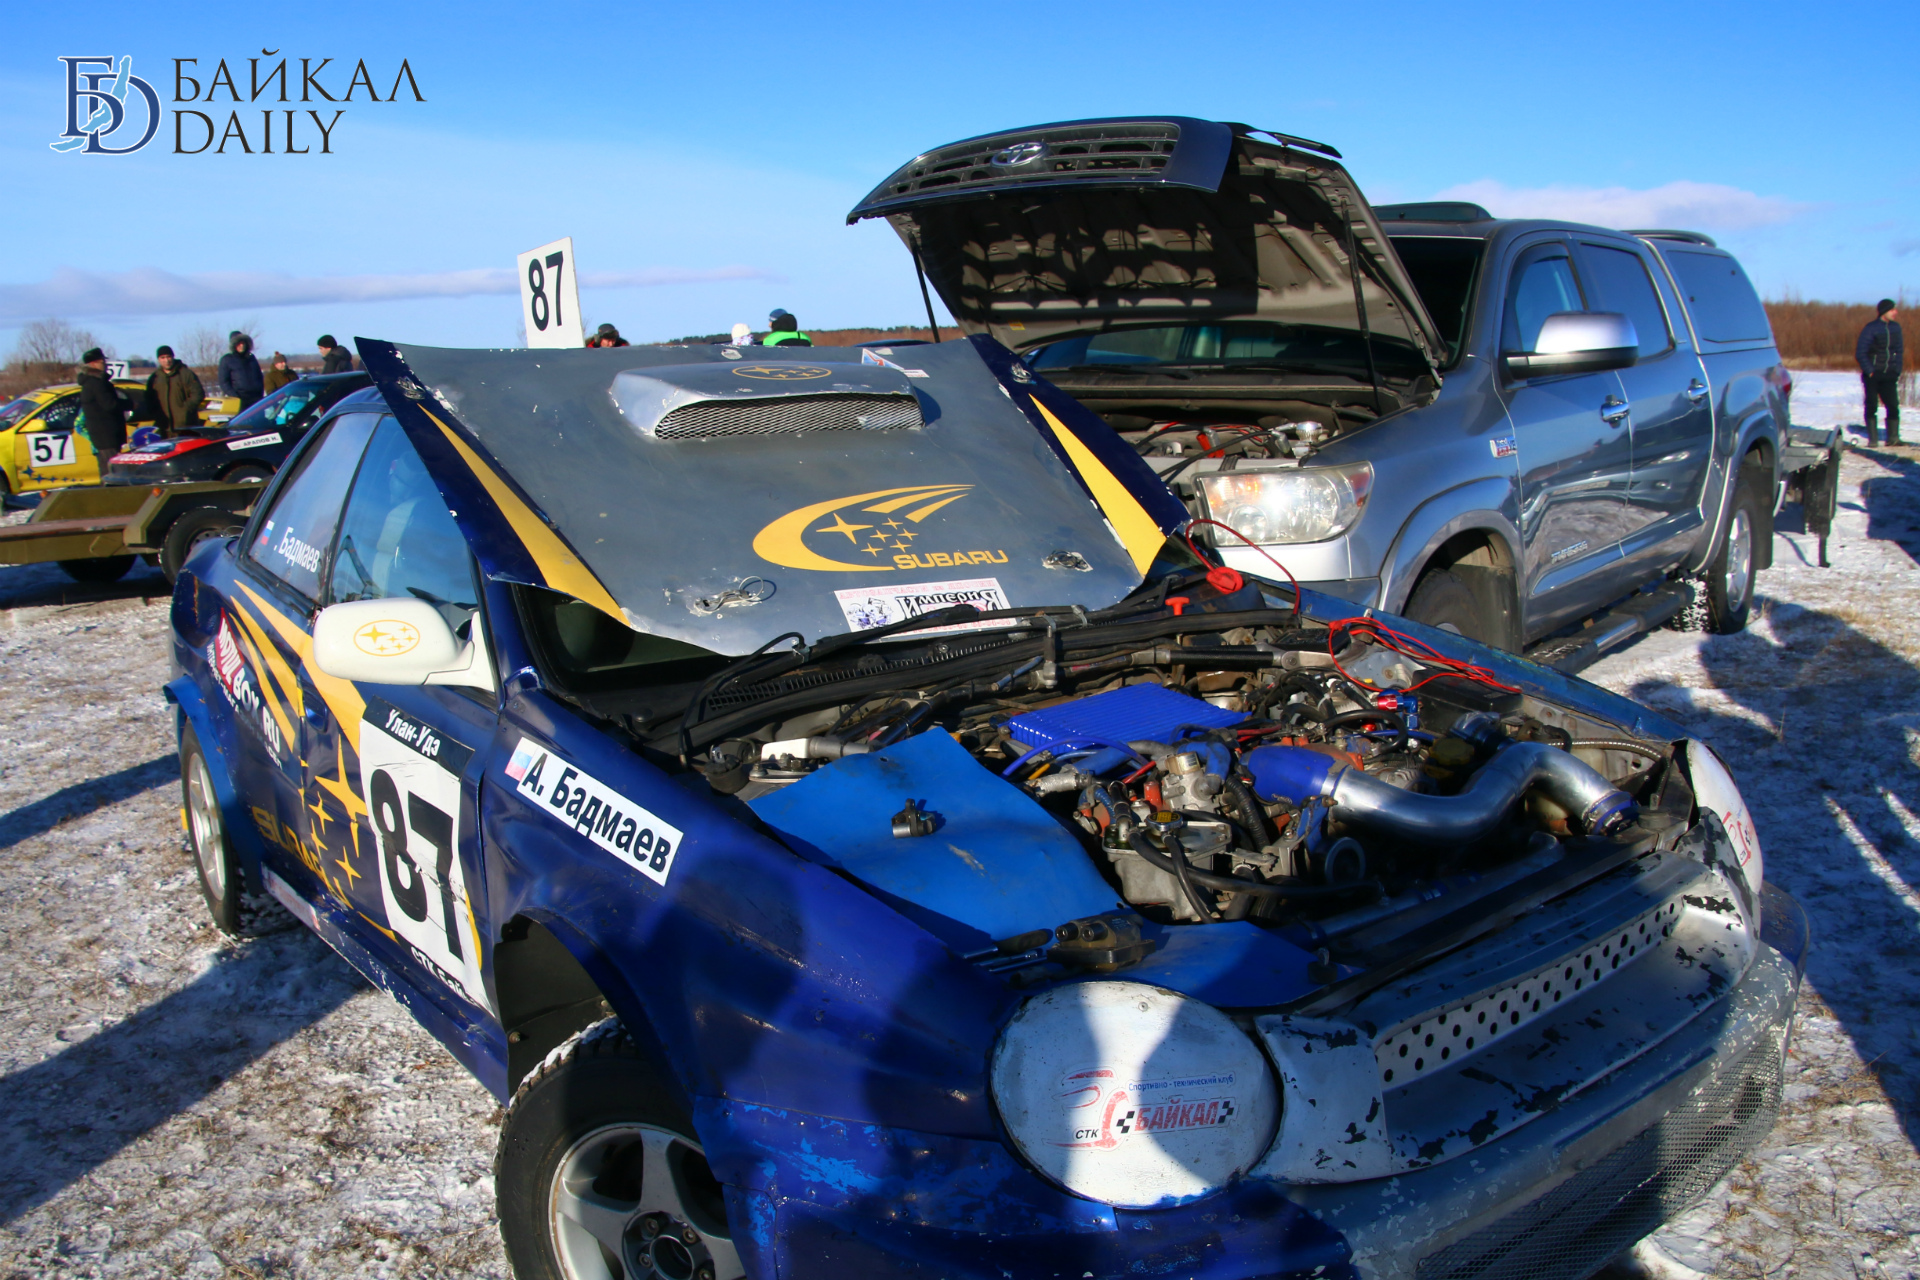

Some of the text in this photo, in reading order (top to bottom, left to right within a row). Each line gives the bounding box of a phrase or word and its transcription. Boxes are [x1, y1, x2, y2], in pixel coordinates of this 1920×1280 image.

[528, 250, 563, 331] 87
[33, 434, 70, 462] 57
[278, 526, 320, 573] Бадмаев
[892, 549, 1009, 570] SUBARU
[385, 708, 441, 757] Улан-Удэ
[521, 752, 672, 873] А. Бадмаев
[370, 769, 465, 965] 87
[1075, 1129, 1099, 1139] СТК
[1134, 1098, 1220, 1131] БАЙКАЛ
